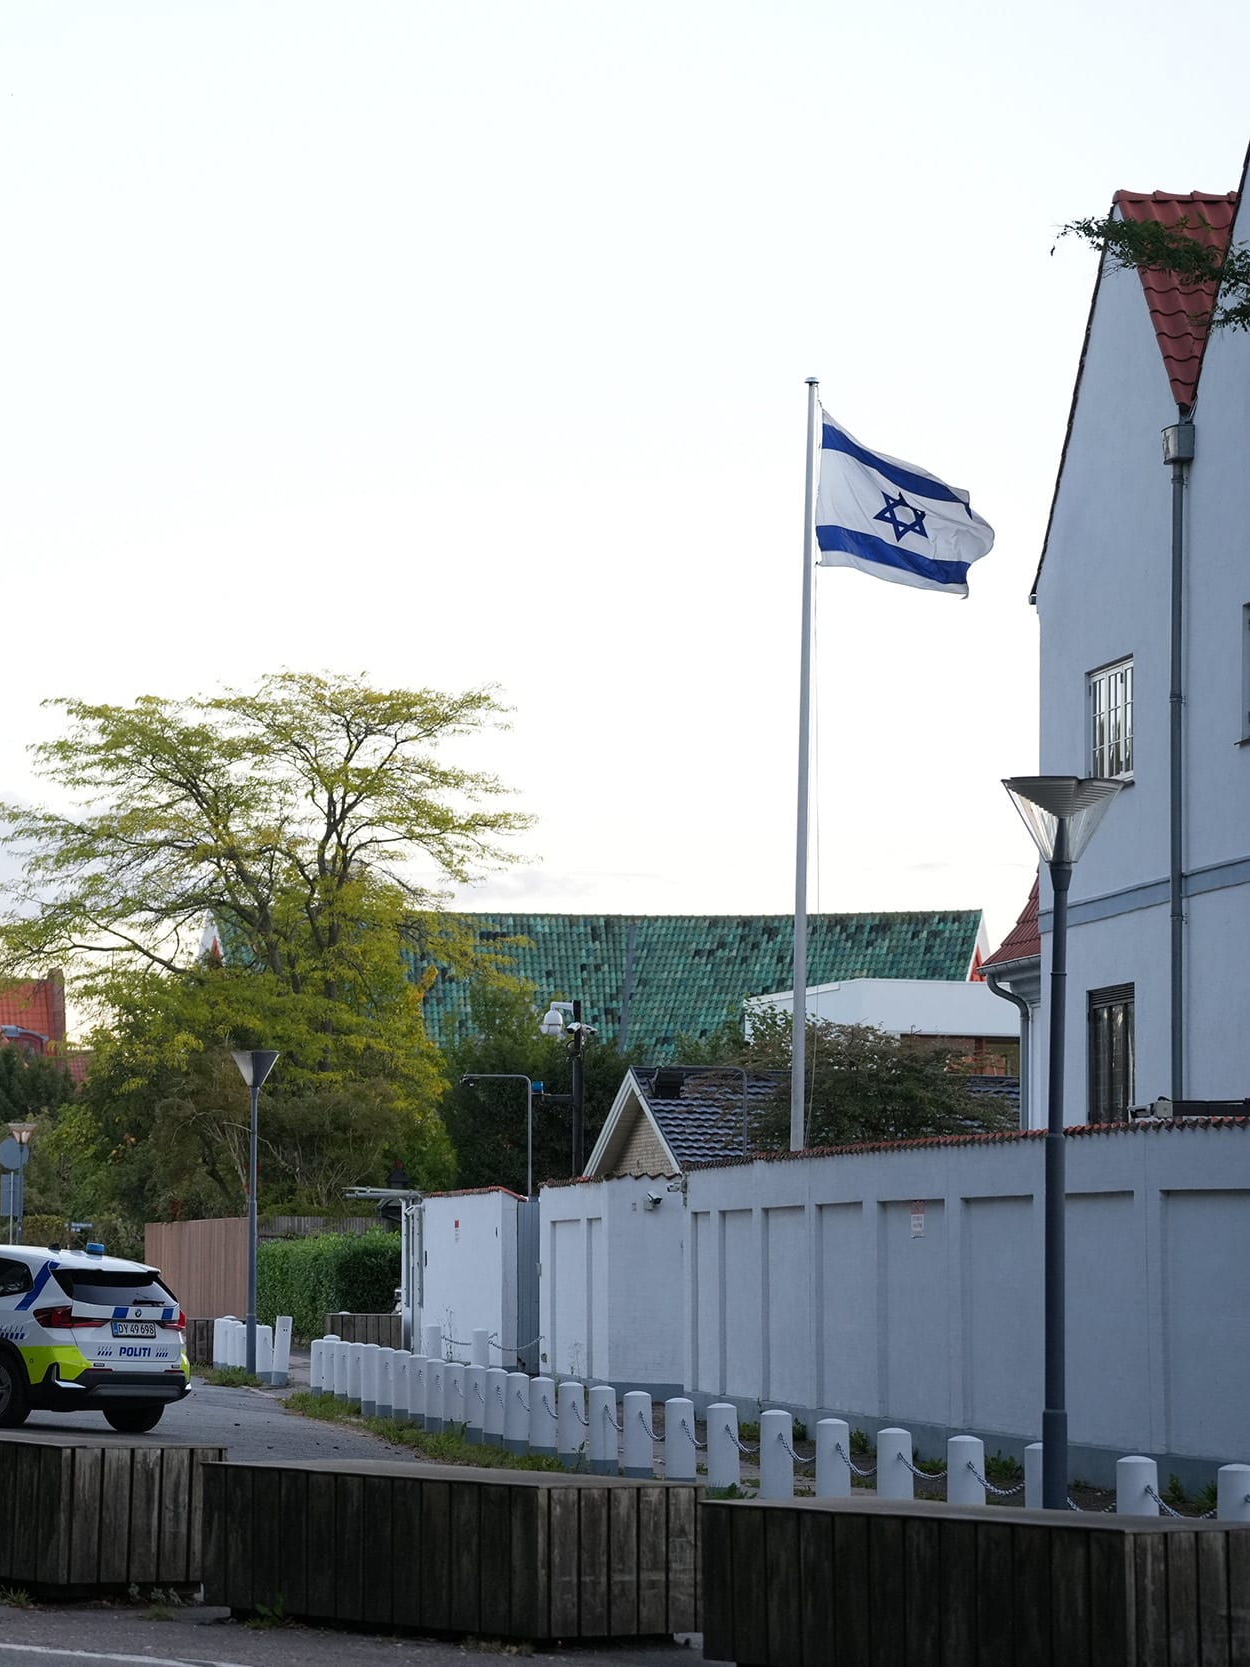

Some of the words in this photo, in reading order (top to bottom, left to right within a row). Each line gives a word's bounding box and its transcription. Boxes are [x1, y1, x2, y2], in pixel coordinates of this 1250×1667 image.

[118, 1323, 128, 1334] DY
[130, 1324, 139, 1334] 49
[119, 1346, 151, 1358] POLITI
